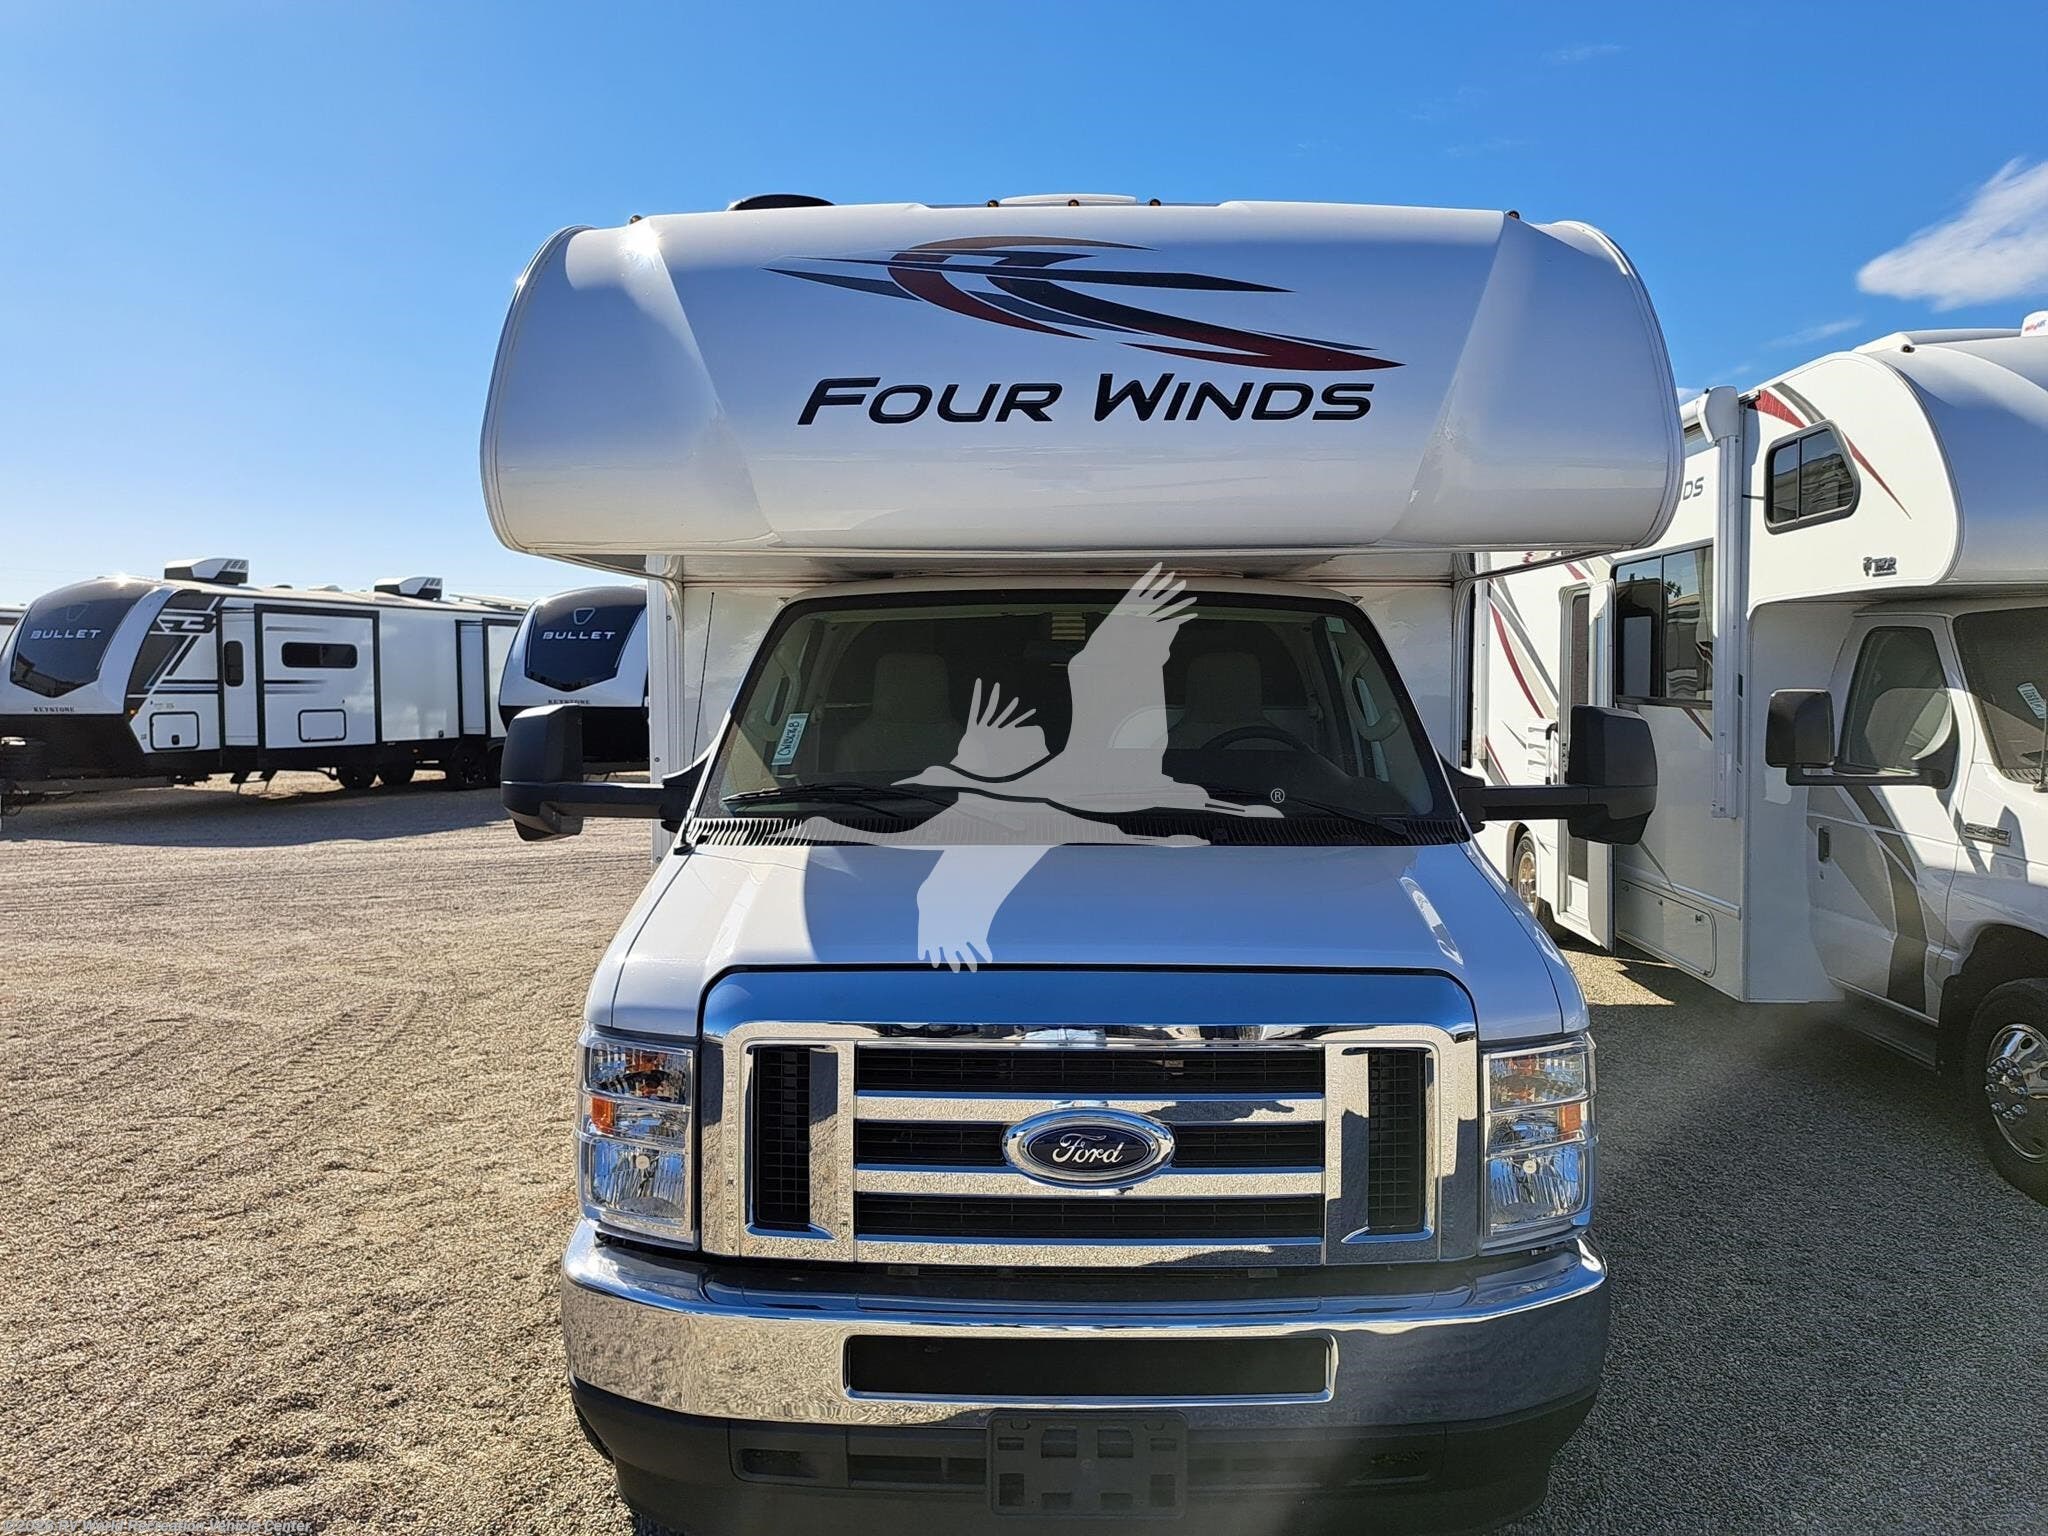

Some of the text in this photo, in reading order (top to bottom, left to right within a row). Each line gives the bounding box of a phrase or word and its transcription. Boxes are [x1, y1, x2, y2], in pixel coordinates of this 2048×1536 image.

[797, 372, 1375, 425] FOUR WINDS
[30, 629, 102, 640] BULLET
[542, 631, 617, 640] BULLET
[33, 705, 76, 713] KEYSTONE
[1052, 1133, 1125, 1163] Ford
